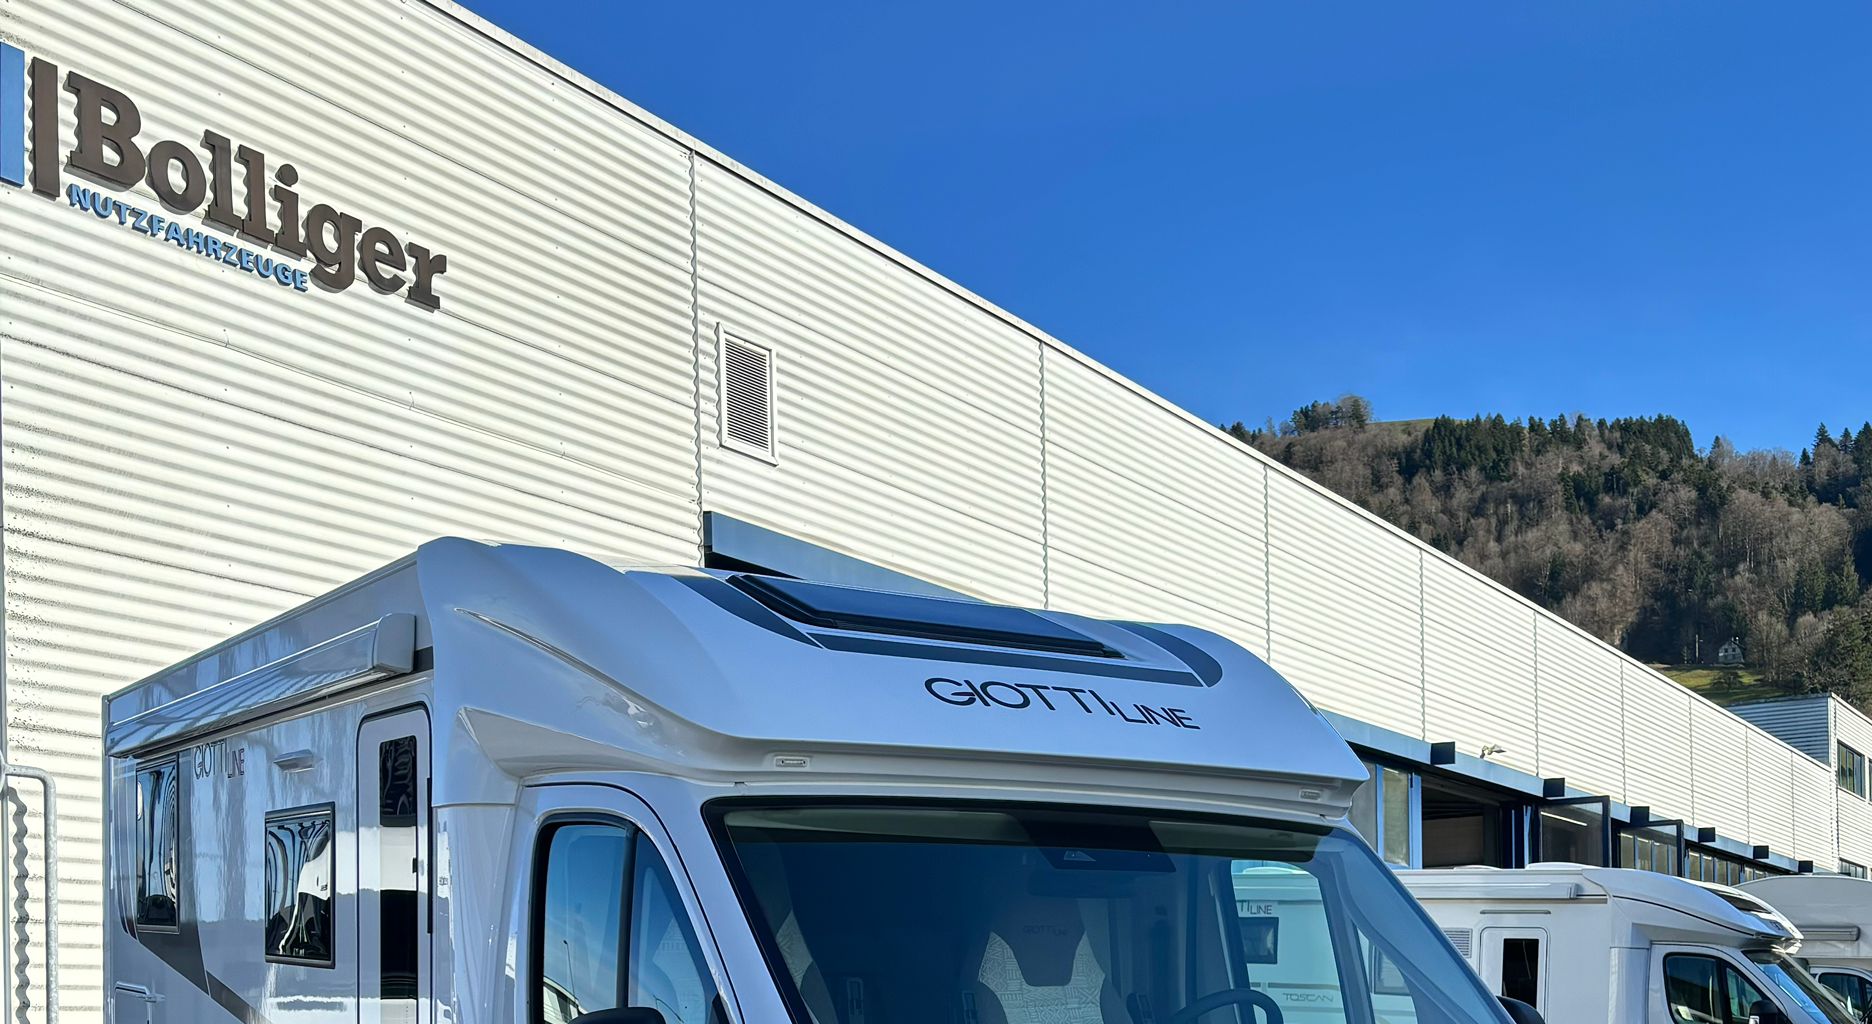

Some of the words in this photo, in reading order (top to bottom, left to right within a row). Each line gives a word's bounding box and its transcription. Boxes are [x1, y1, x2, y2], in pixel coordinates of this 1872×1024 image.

[65, 70, 447, 312] Bolliger
[69, 183, 309, 292] NUTZFAHRZEUGE
[1282, 992, 1335, 1003] TOSCAN
